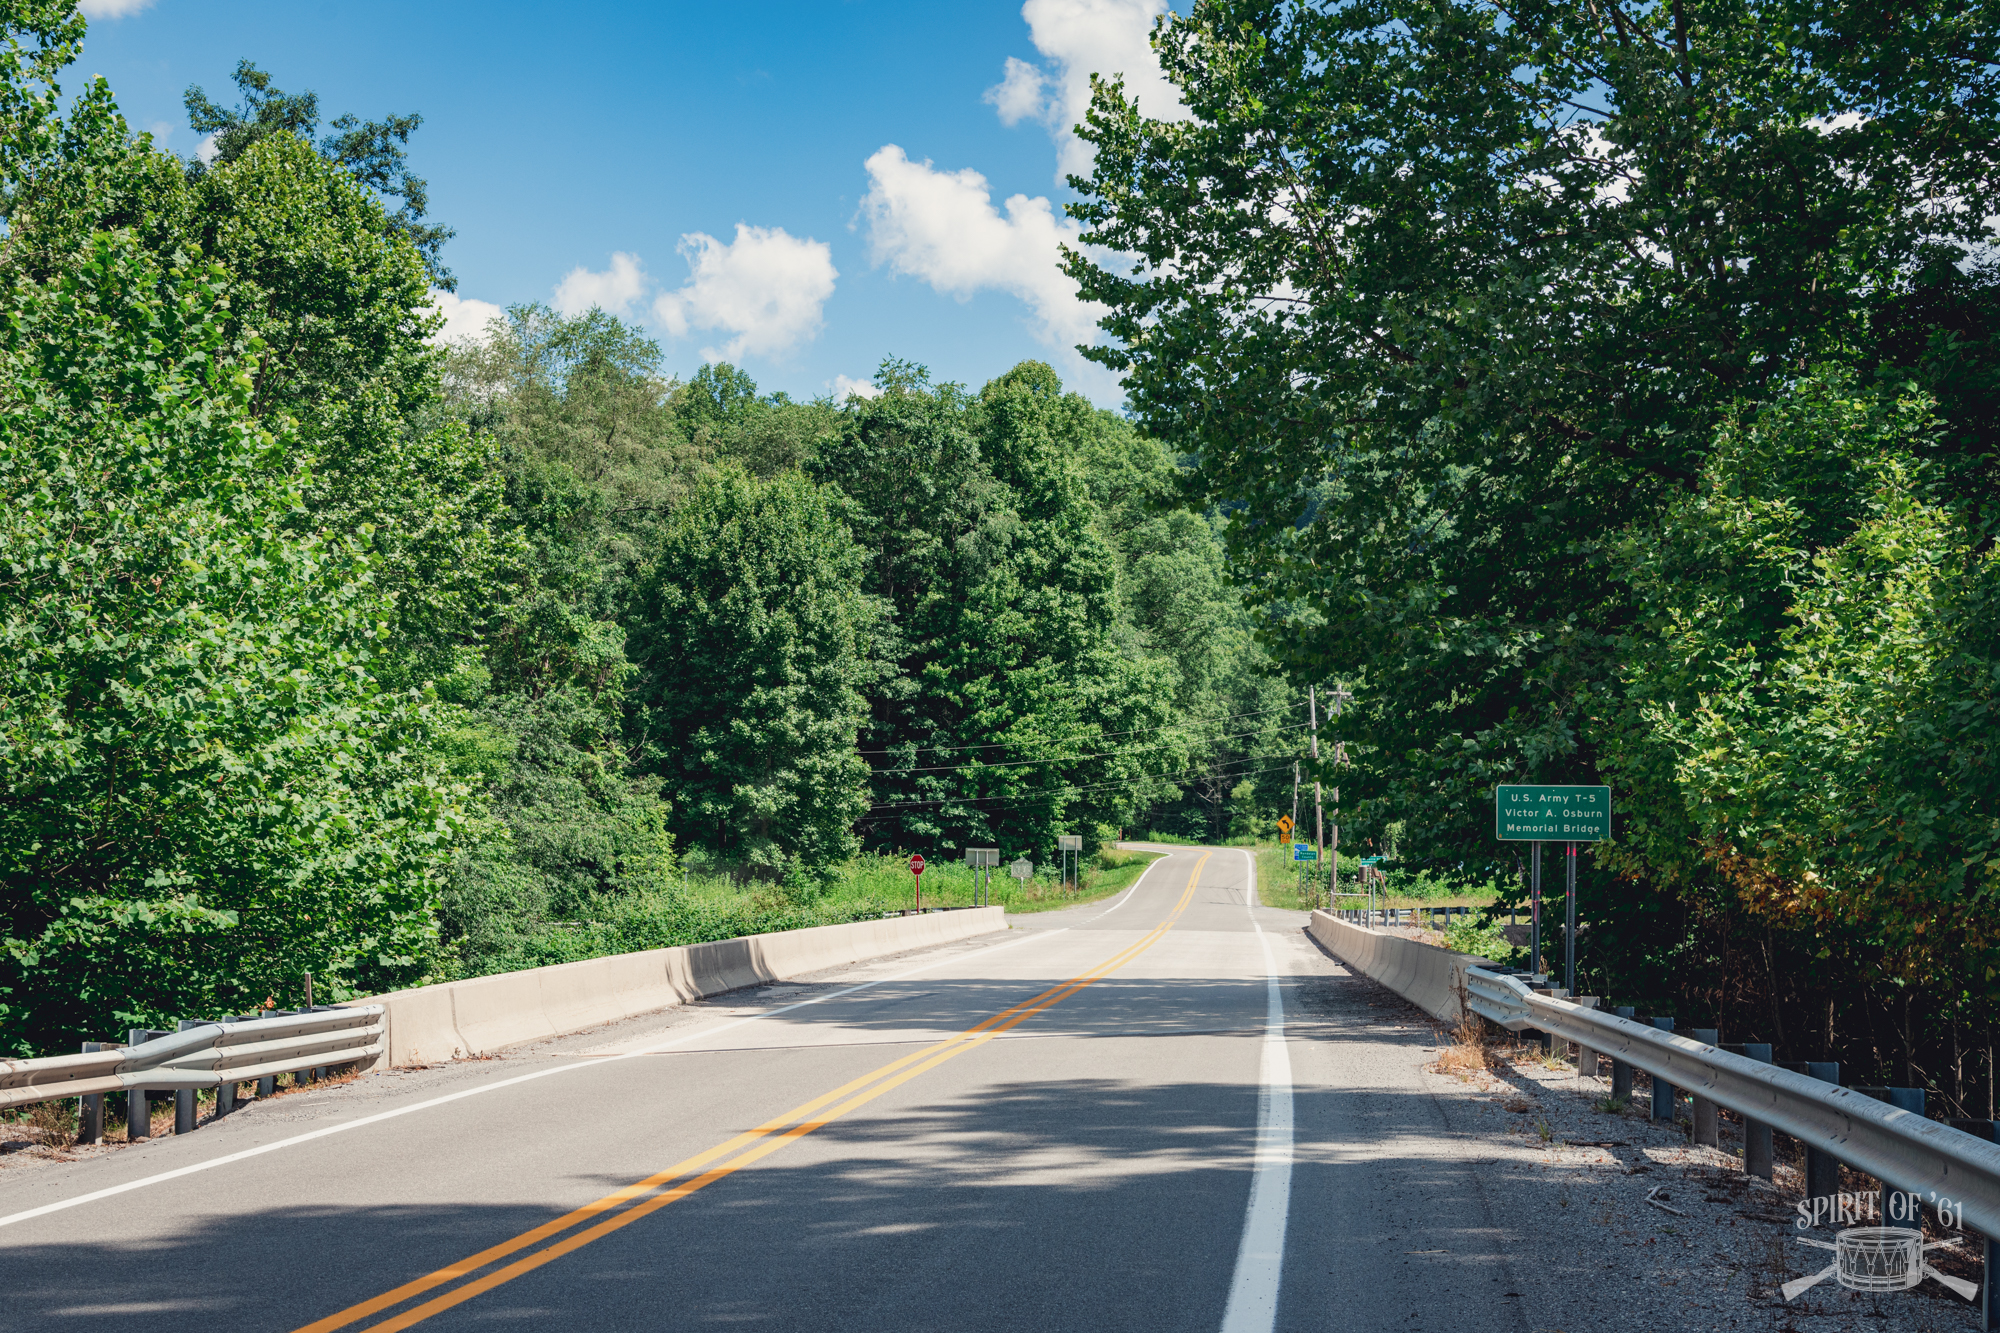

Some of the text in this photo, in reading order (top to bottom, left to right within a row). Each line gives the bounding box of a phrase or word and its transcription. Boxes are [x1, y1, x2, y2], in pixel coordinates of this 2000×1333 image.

[1511, 794, 1596, 804] U.S. Army T-5
[1505, 809, 1603, 818] Victor A. Osburn
[1506, 824, 1600, 835] Memorial Bridge
[910, 861, 924, 869] STOP
